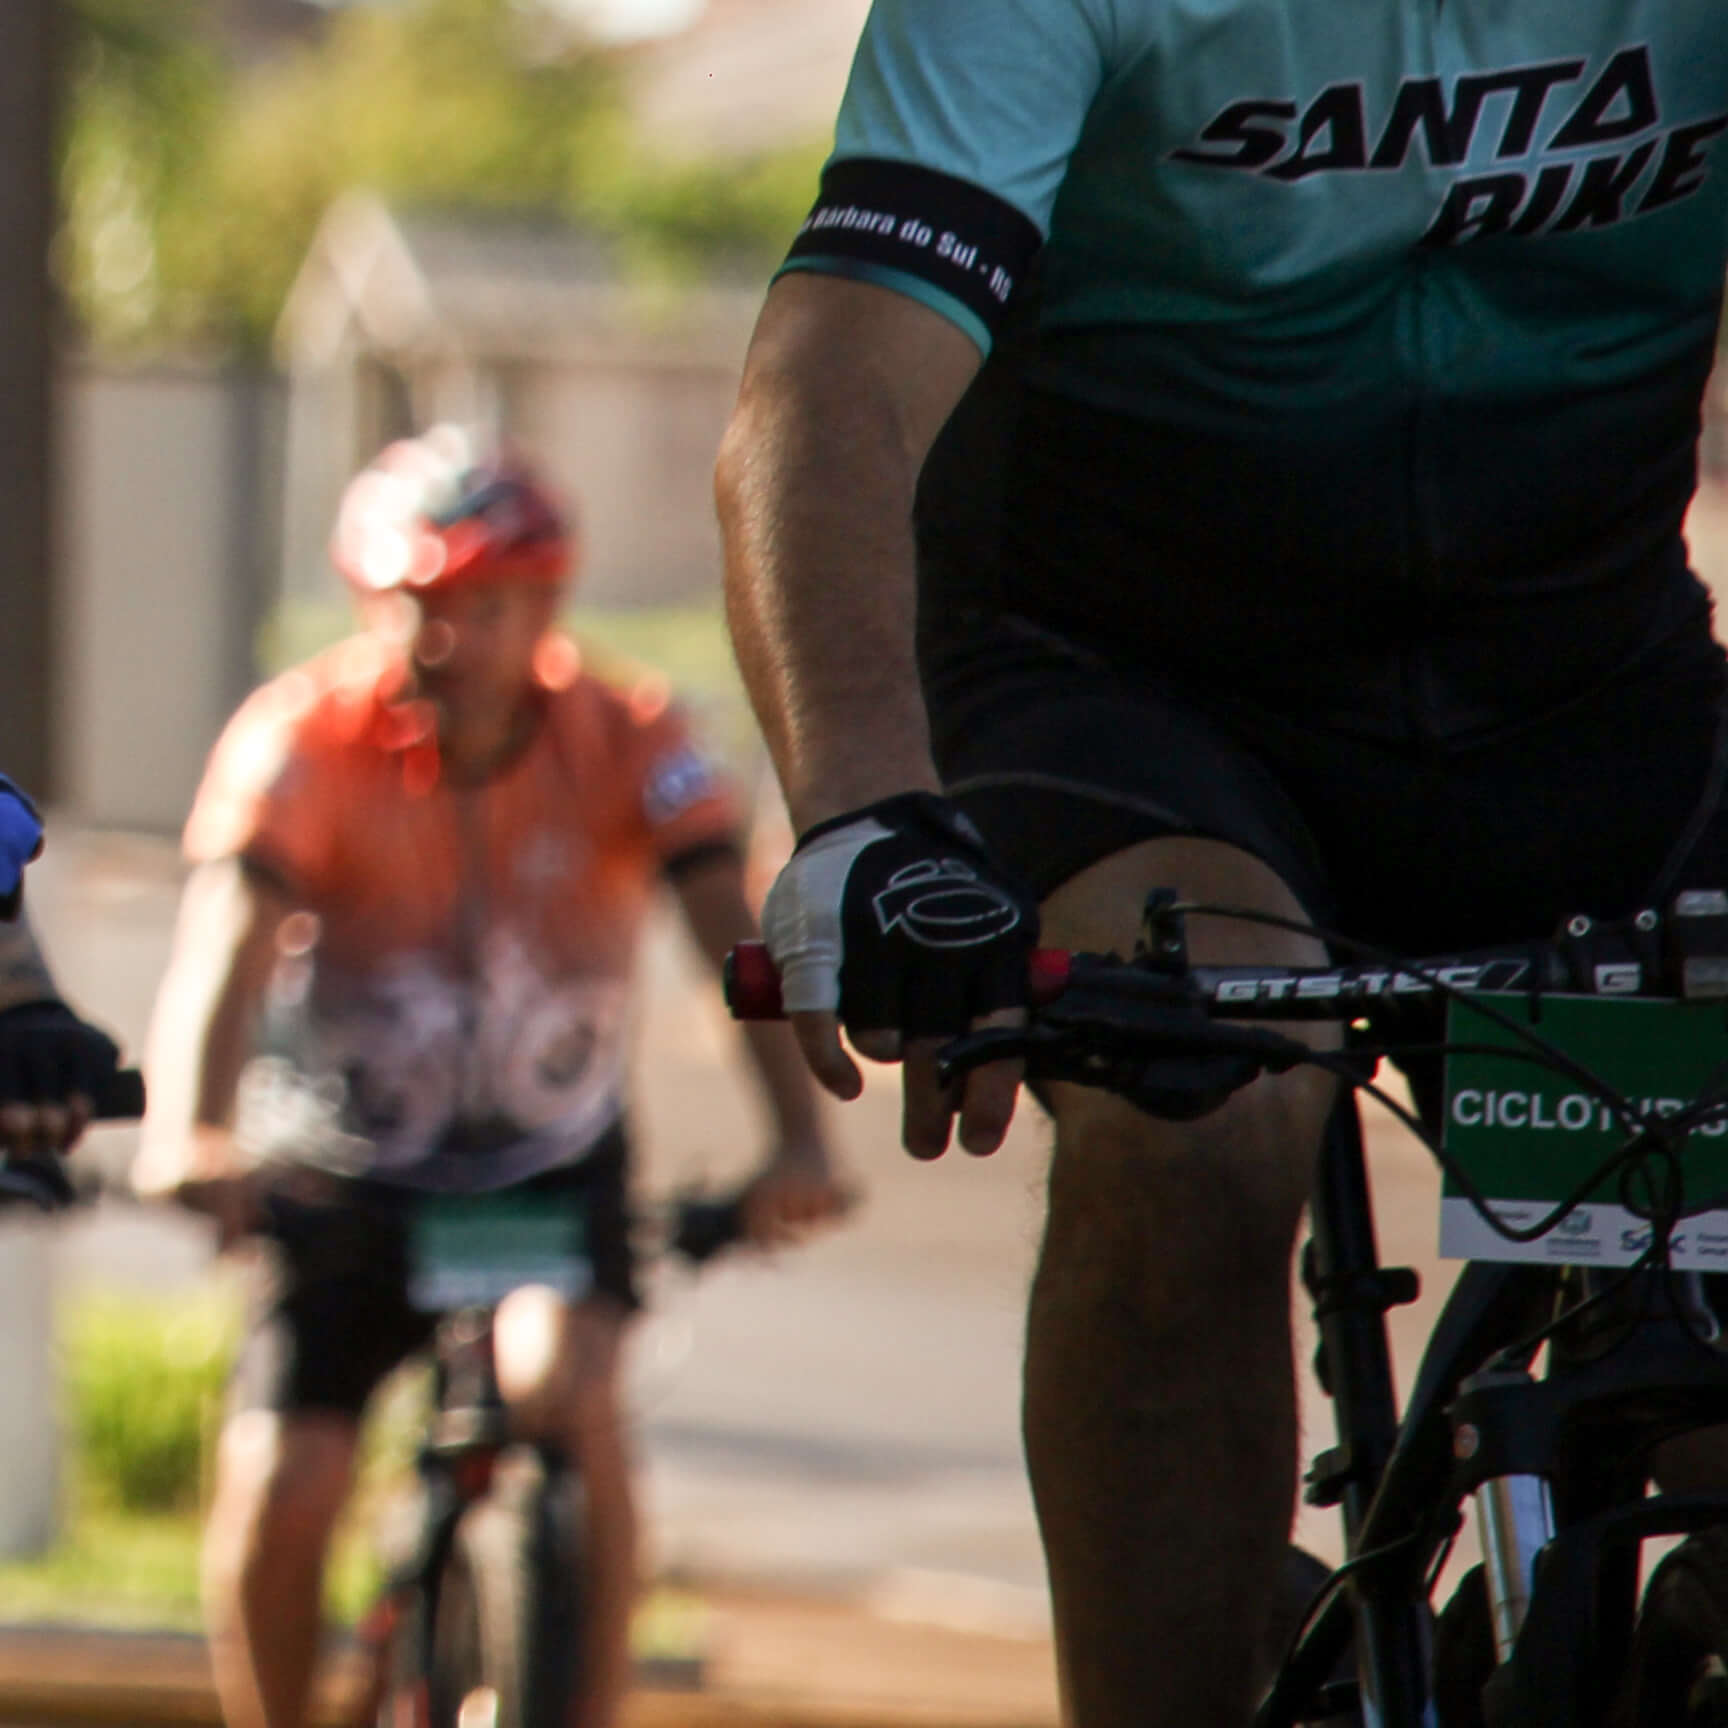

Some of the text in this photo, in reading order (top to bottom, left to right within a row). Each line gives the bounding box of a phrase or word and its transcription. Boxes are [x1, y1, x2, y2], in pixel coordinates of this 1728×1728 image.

[1164, 44, 1660, 183] SANTA
[899, 219, 933, 248] do
[935, 231, 978, 270] Sul
[1420, 114, 1728, 248] BIKE
